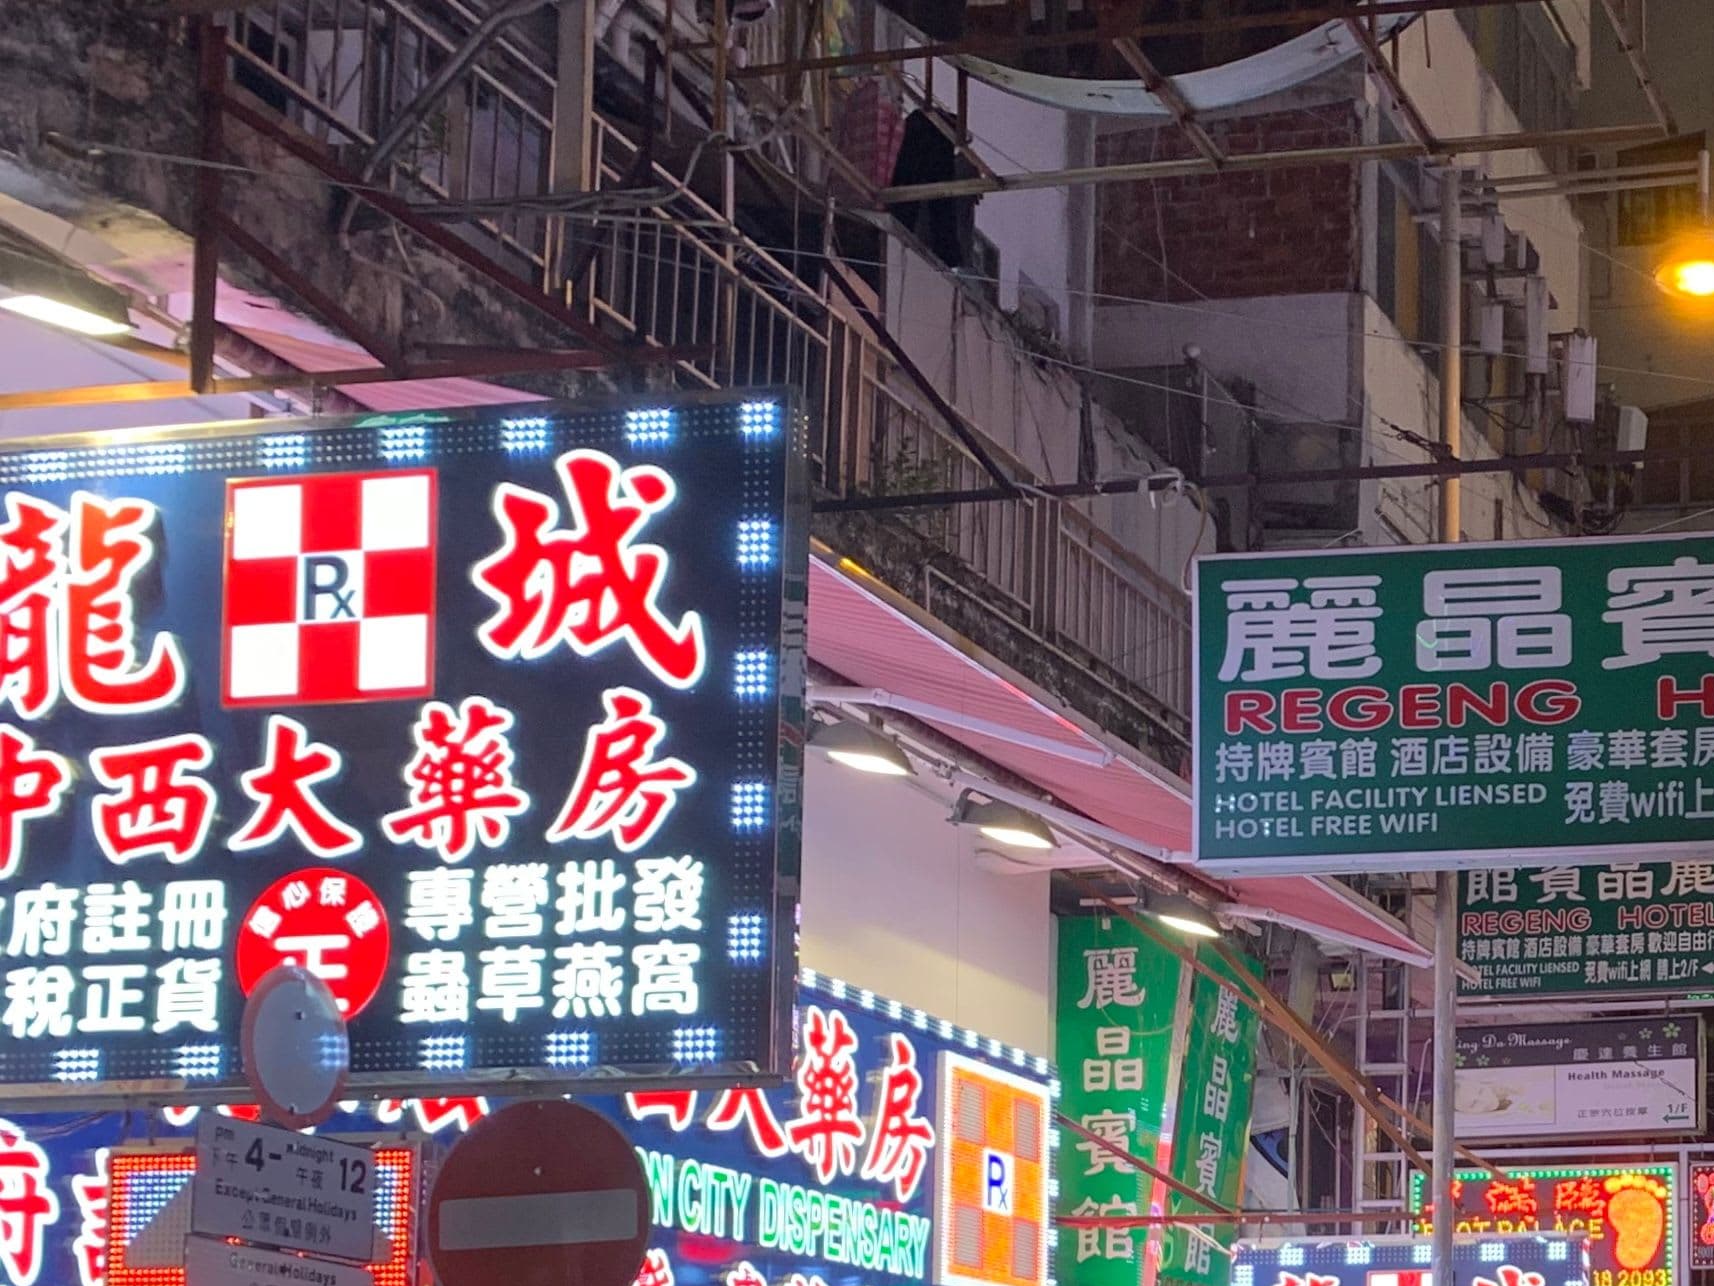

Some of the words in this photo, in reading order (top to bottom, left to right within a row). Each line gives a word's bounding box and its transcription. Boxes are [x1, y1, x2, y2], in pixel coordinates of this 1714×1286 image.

[0, 489, 184, 719] 龍
[470, 449, 706, 689] 城
[1224, 678, 1582, 735] REGENG
[1215, 736, 1377, 783] 持牌賓館
[1390, 731, 1555, 777] 酒店設備
[0, 687, 698, 878] 中西大藥房
[1215, 789, 1303, 814] HOTEL
[1309, 785, 1428, 812] FACILITY
[1435, 782, 1547, 808] LIENSED
[1215, 815, 1304, 840] HOTEL
[1311, 813, 1372, 837] FREE
[1379, 811, 1438, 835] WIFI
[403, 856, 705, 942] 專營批發
[0, 878, 229, 956] 府註冊
[1462, 907, 1592, 936] REGENG
[1524, 936, 1583, 958] 酒店設備
[1586, 934, 1645, 957] 豪華套房
[400, 941, 702, 1022] 蟲草燕窩
[1495, 962, 1537, 976] FACILITY
[1539, 961, 1580, 974] LIENSED
[1495, 977, 1517, 989] FREE
[1520, 976, 1541, 988] WIFI
[1568, 1070, 1607, 1081] Health
[1612, 1067, 1665, 1080] Massage
[1072, 947, 1147, 1264] 麗晶賓館
[1668, 1103, 1688, 1115] 1/F
[339, 1157, 366, 1194] 12
[308, 1197, 357, 1221] Holidays
[678, 1160, 752, 1241] CITY
[760, 1177, 930, 1280] DISPENSARY
[284, 1263, 337, 1286] Holidays
